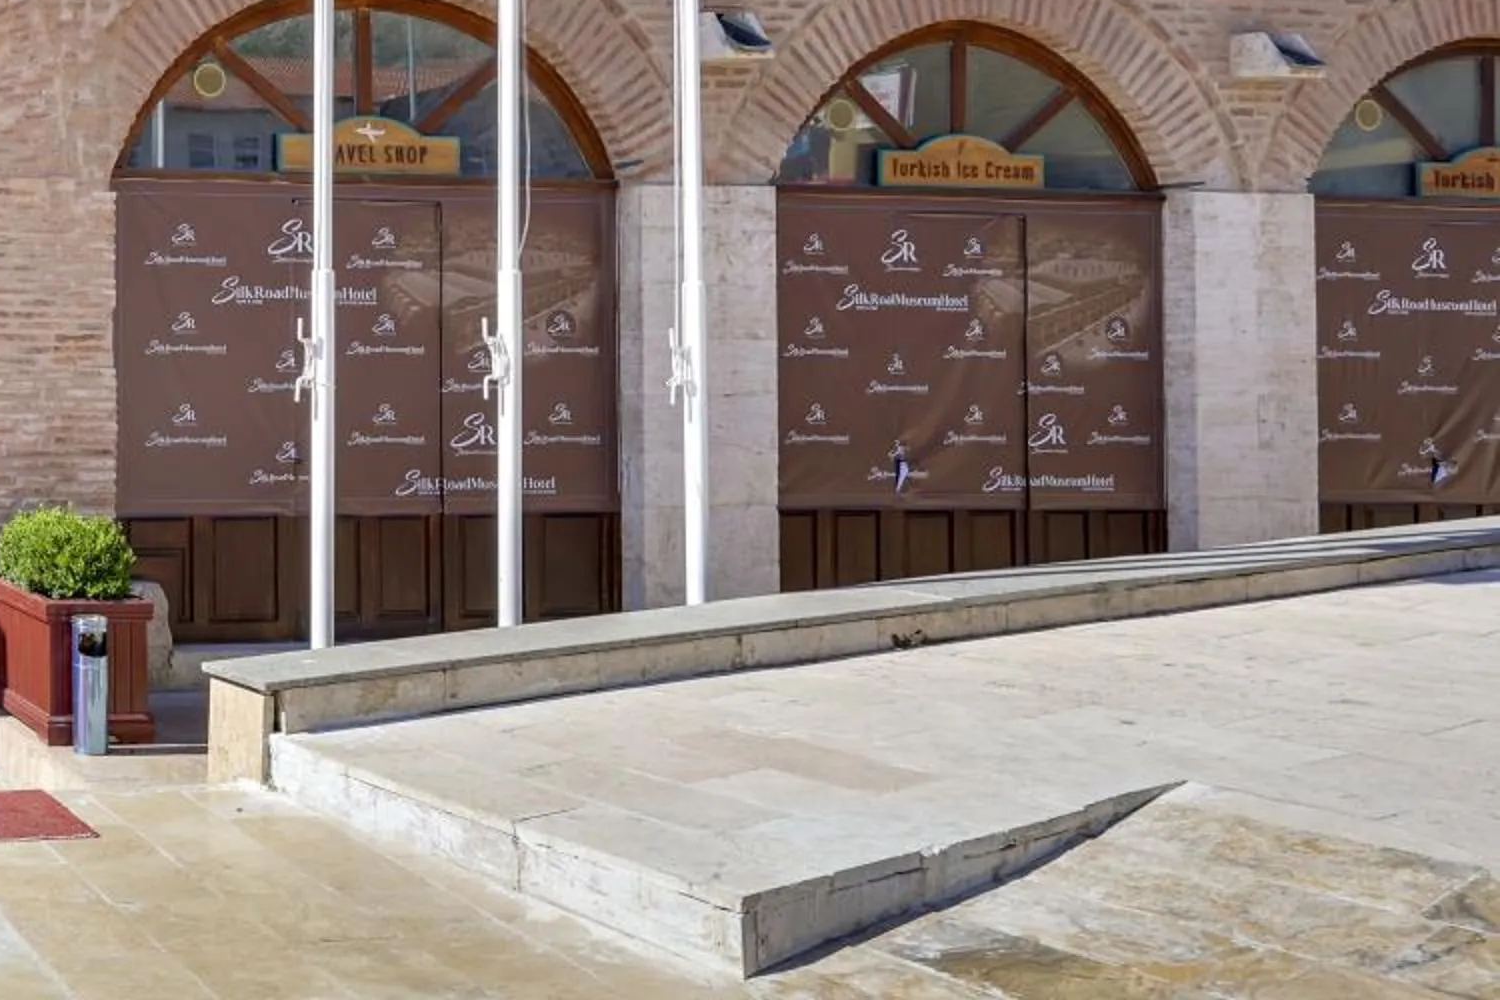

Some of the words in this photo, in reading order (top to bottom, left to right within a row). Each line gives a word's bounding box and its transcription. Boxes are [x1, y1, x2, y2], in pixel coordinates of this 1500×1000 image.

[335, 144, 375, 163] AVEL
[385, 146, 428, 164] SHOP
[892, 158, 950, 180] Turkish
[957, 160, 979, 179] Ice
[985, 161, 1036, 181] Cream
